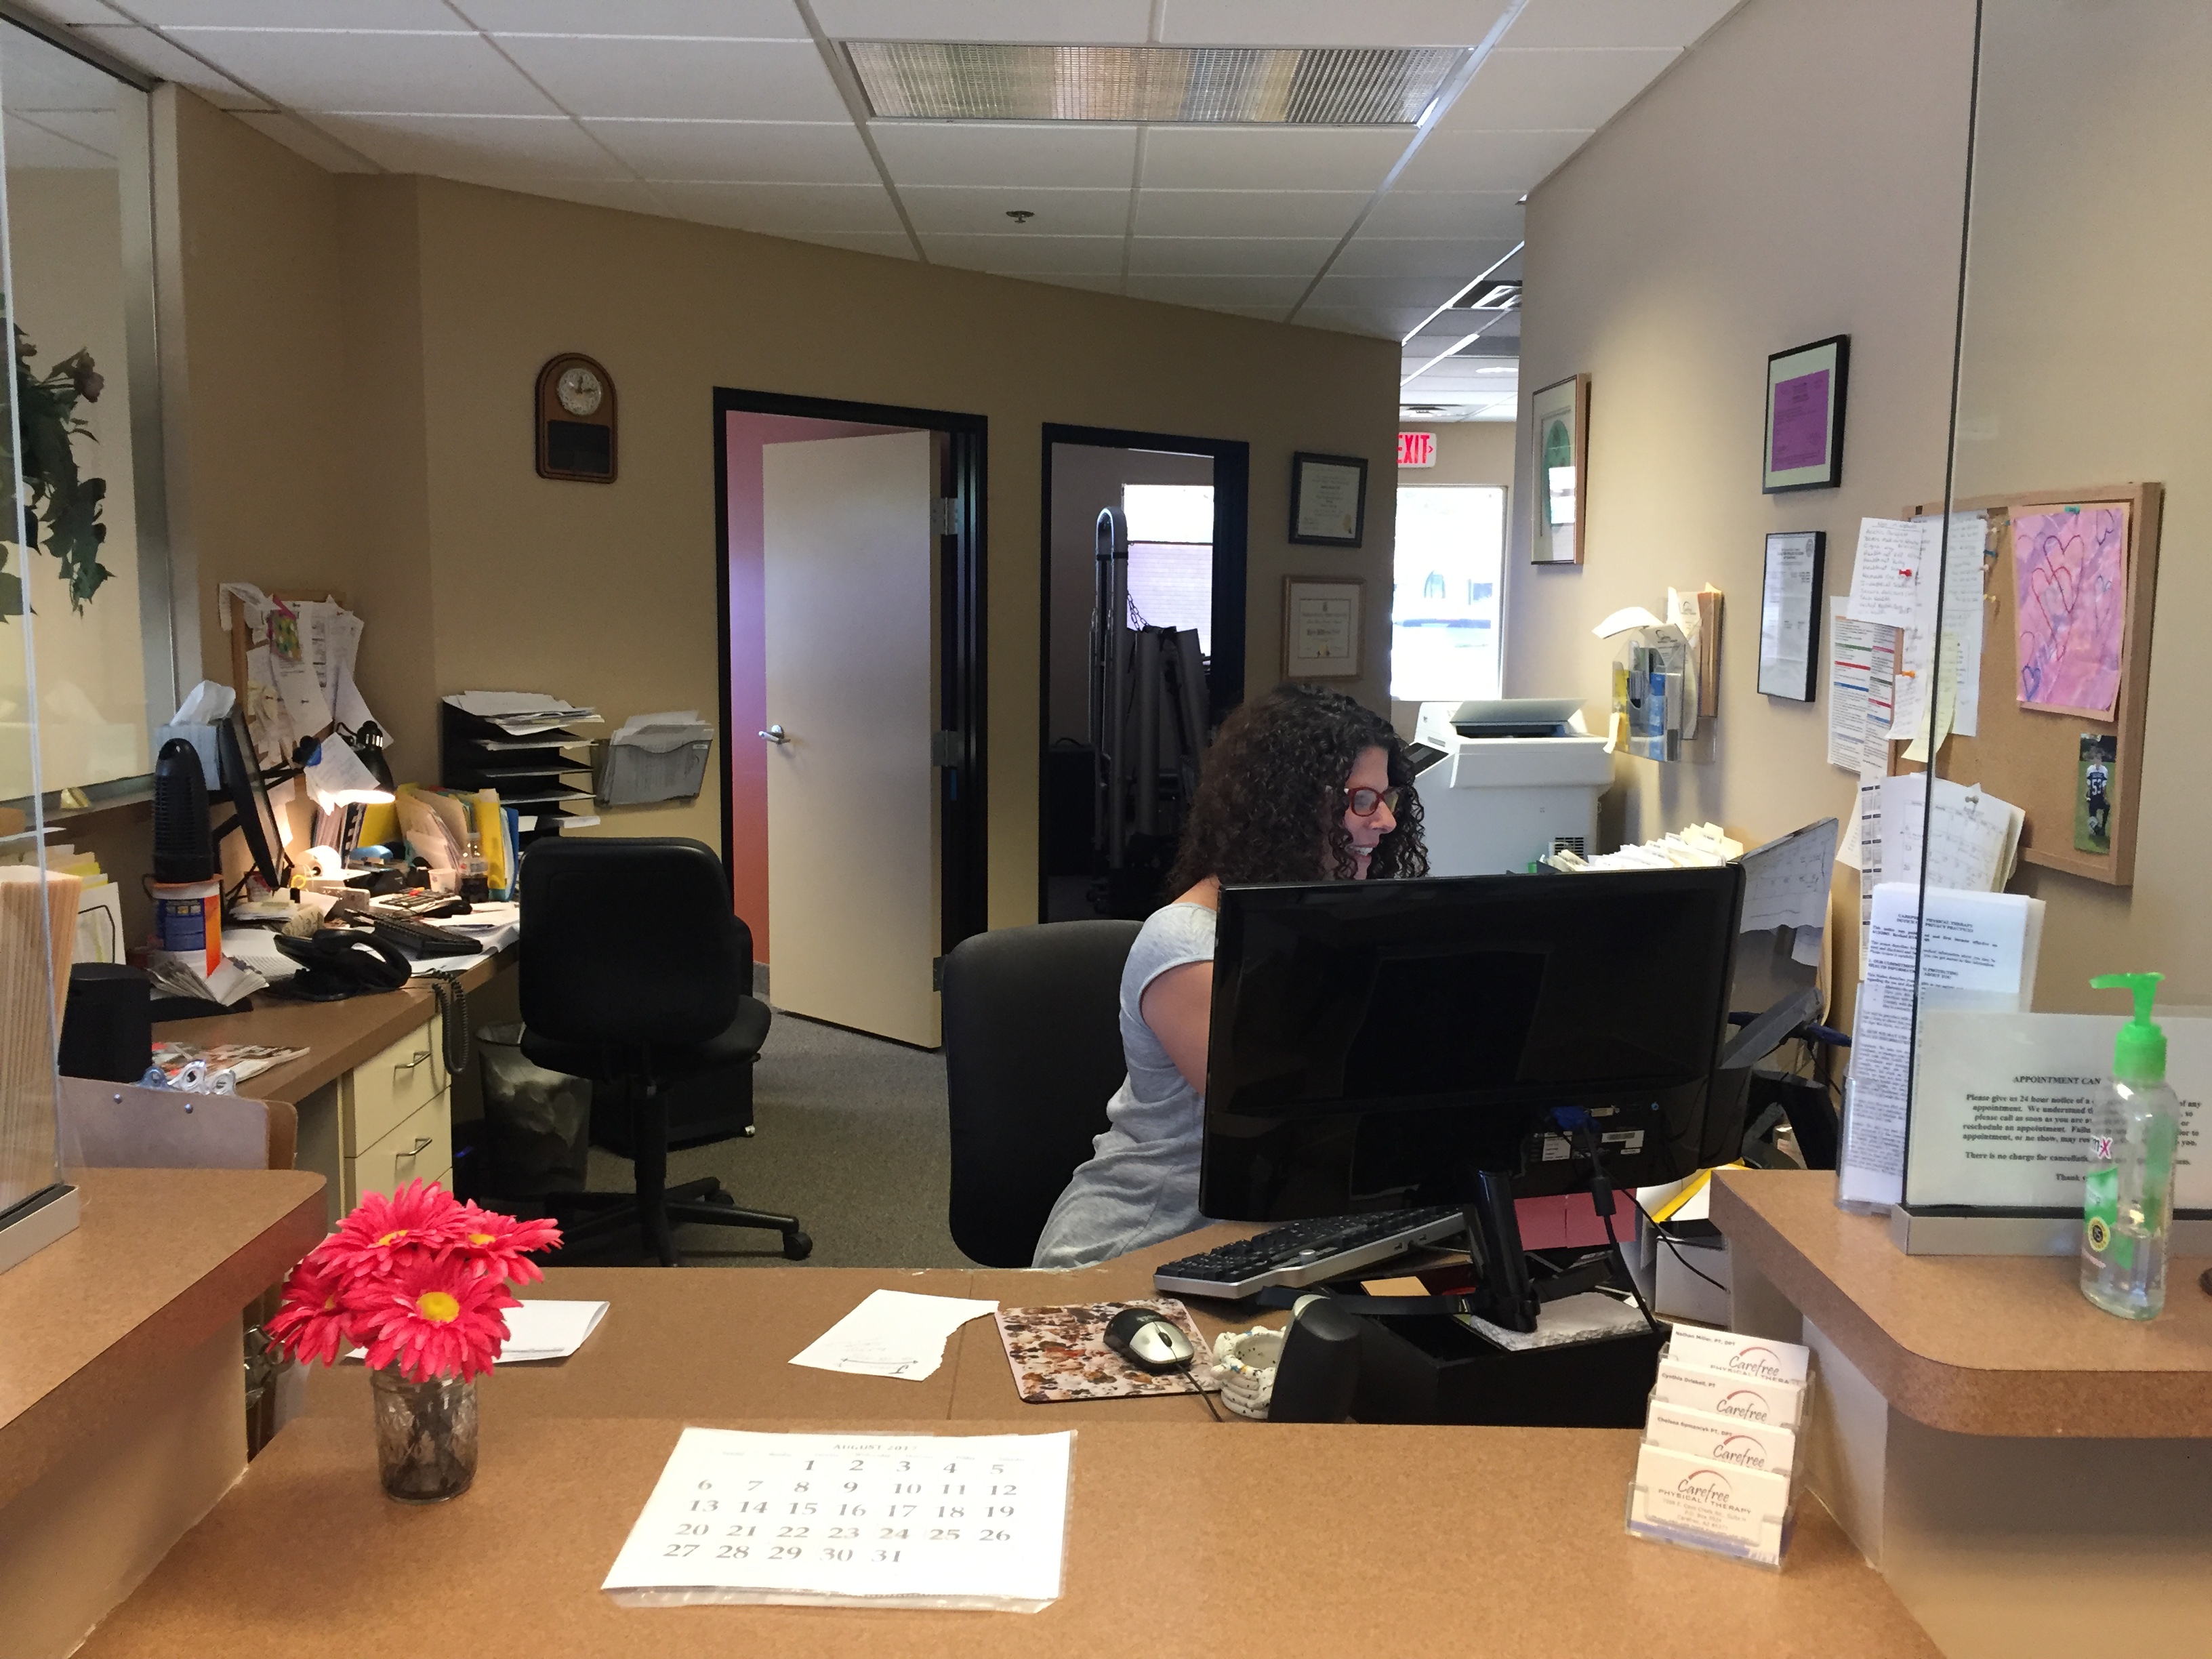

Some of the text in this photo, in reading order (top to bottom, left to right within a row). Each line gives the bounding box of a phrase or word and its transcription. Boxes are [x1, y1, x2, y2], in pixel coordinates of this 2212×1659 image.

[1397, 434, 1430, 464] EXIT
[2013, 1076, 2080, 1085] APPOINTMENT
[1973, 1105, 2023, 1113] appointment.
[1965, 1151, 1987, 1160] There
[2056, 1173, 2081, 1181] Thank
[1729, 1355, 1780, 1377] Carefree
[1716, 1398, 1767, 1422] Carefree
[1713, 1444, 1765, 1468] Carefree
[804, 1459, 1004, 1475] 1 2 3 4 5
[697, 1479, 1018, 1496] 6 7 8 9 10 11 12
[1677, 1479, 1729, 1502] Carefree
[689, 1500, 1015, 1519] 13 14 15 16 17 18 19
[1658, 1488, 1751, 1515] PHYSICAL THERAPY
[676, 1523, 1011, 1542] 20 21 22 23 24 25 26
[663, 1544, 901, 1563] 27 28 29 30 31
